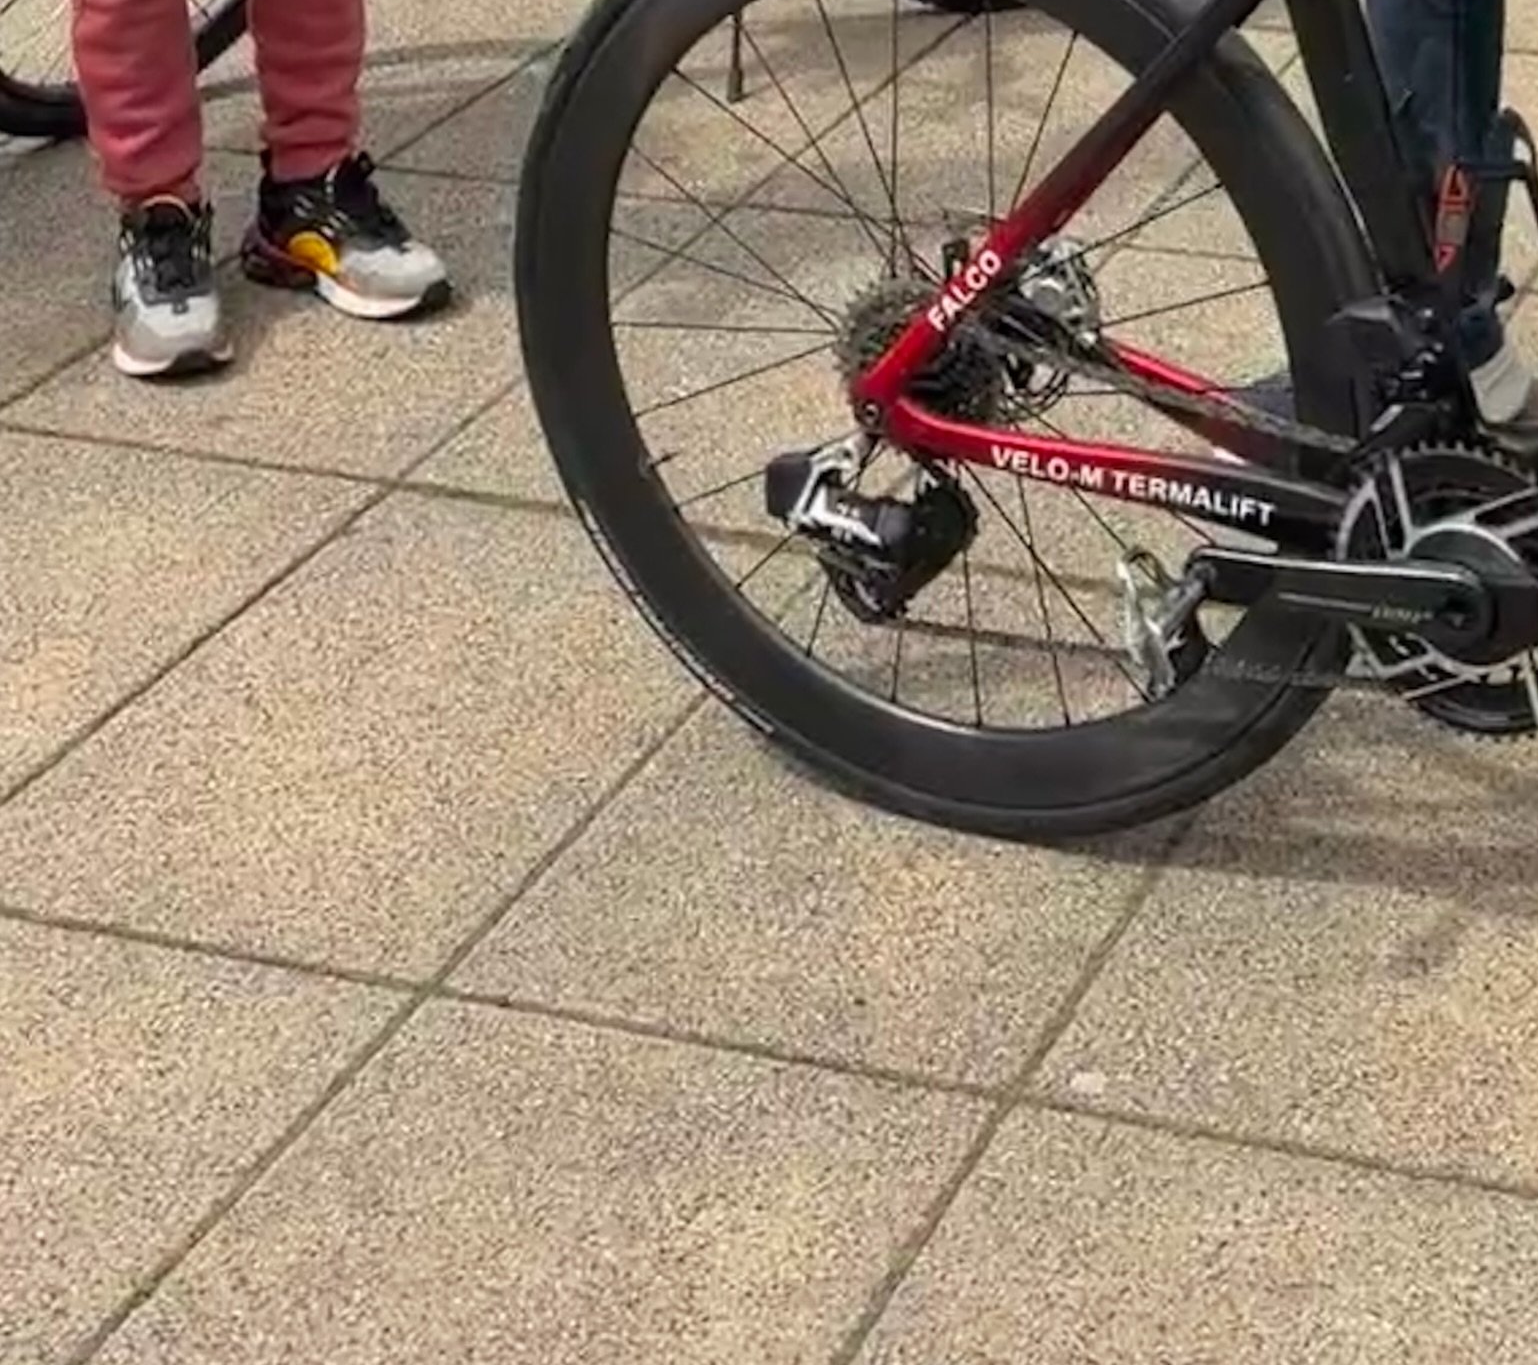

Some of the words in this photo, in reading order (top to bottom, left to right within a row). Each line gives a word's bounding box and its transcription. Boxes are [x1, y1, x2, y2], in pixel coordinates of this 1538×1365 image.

[928, 248, 1002, 333] FALCO
[990, 445, 1106, 491] VELO-M
[1112, 470, 1277, 529] TERMALIFT
